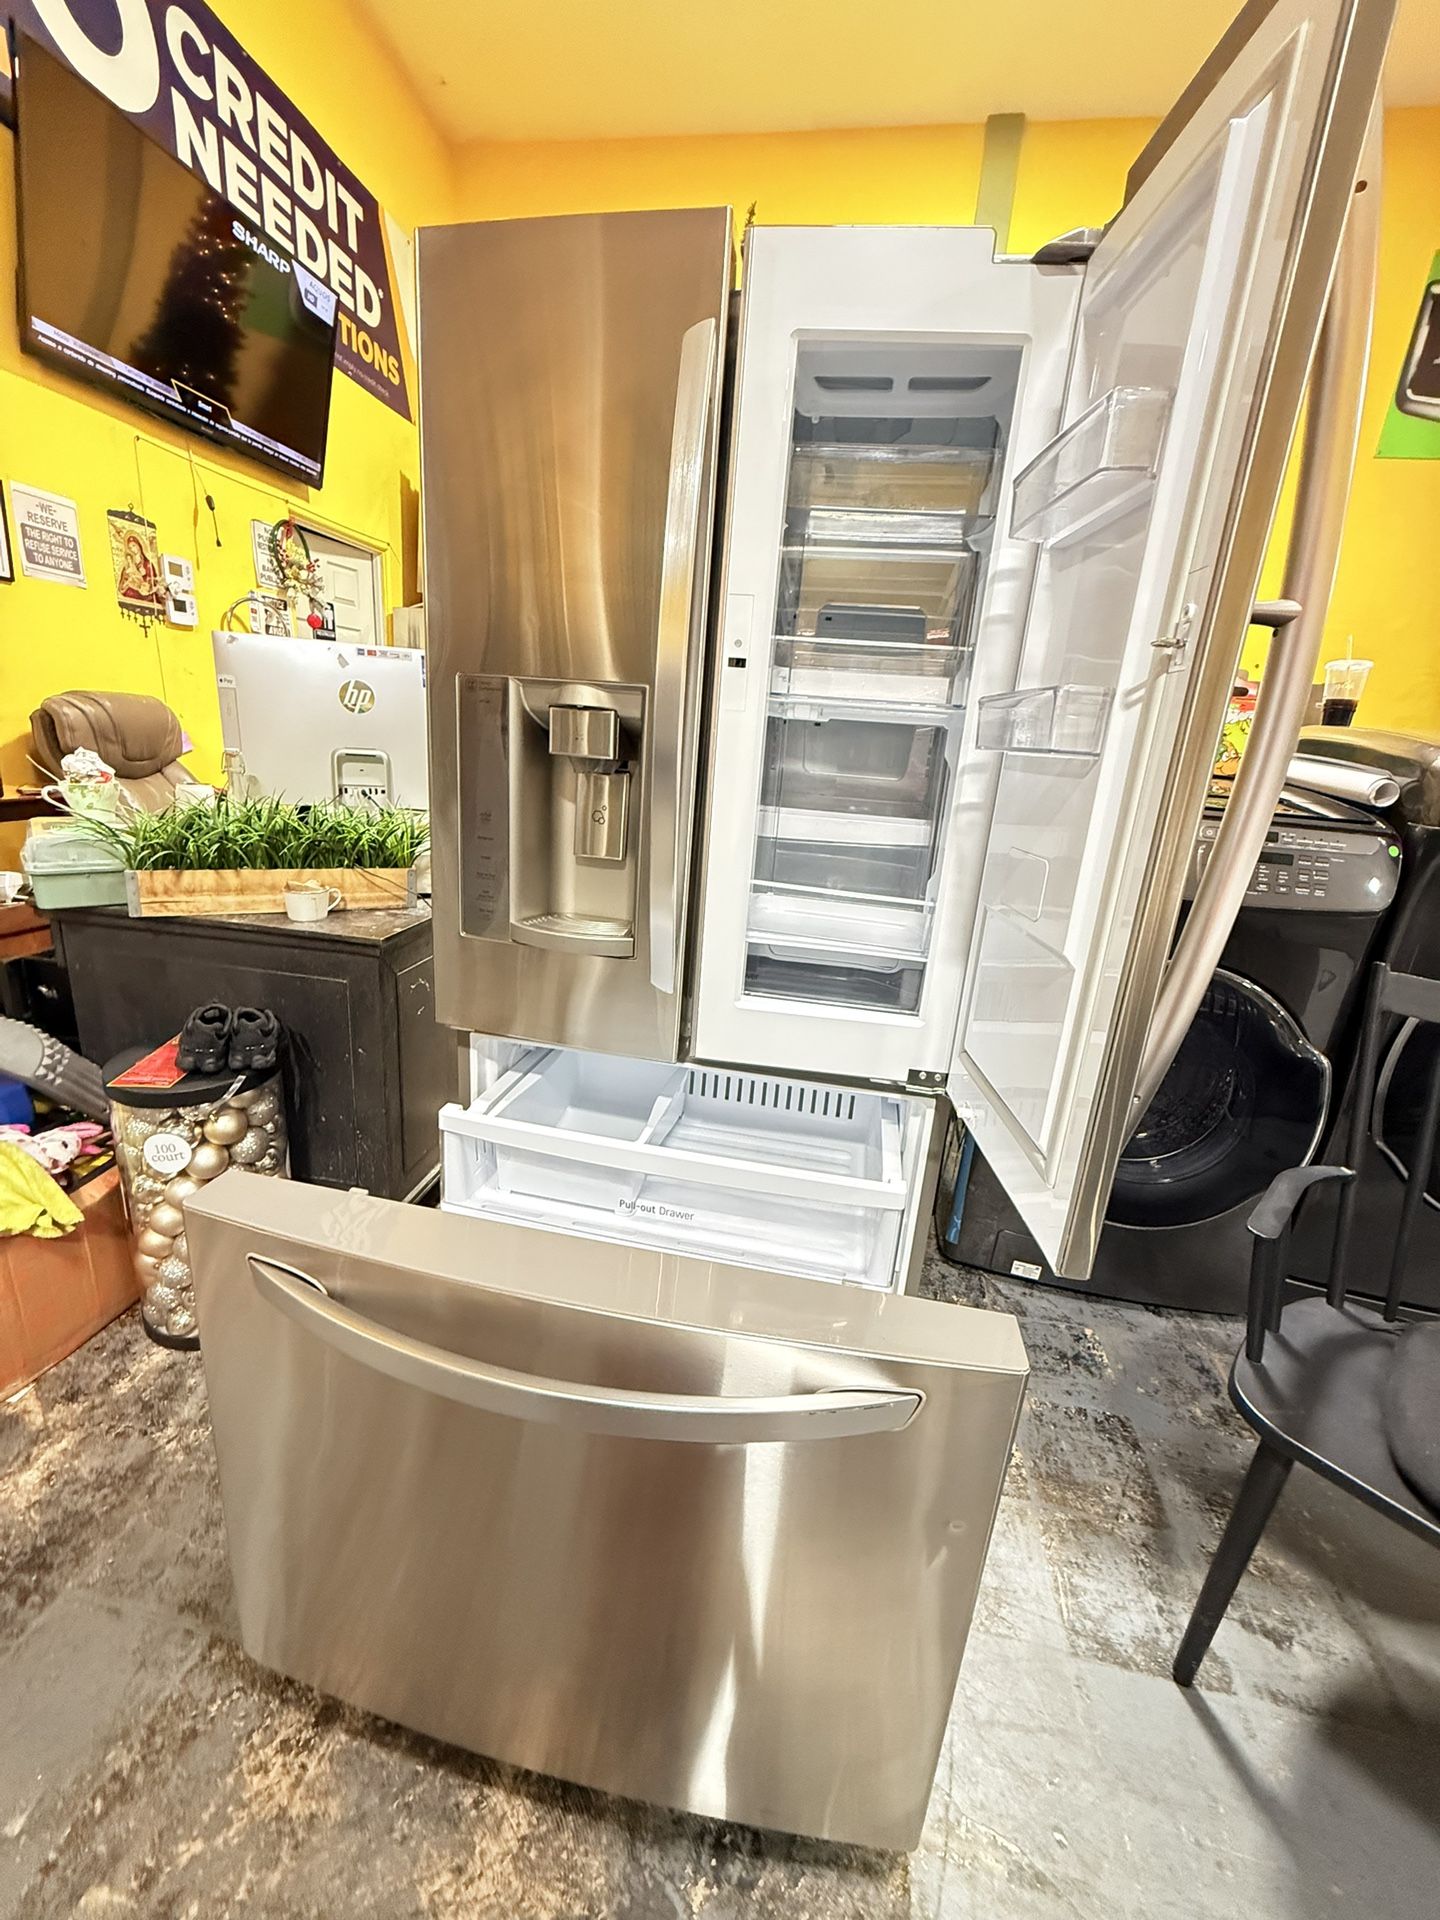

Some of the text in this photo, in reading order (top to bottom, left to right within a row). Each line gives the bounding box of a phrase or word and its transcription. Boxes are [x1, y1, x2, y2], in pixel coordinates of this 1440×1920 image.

[165, 5, 364, 254] CREDIT
[232, 220, 292, 274] SHARP
[338, 311, 401, 386] TIONS
[27, 510, 68, 532] RESERVE
[25, 526, 74, 549] THE RIGHT TO
[25, 538, 78, 561] REFUSE SERVICE
[33, 551, 74, 571] TO ANYONE
[343, 680, 371, 714] hp
[154, 1143, 176, 1154] 100
[619, 1199, 695, 1221] Pull-out Drawer
